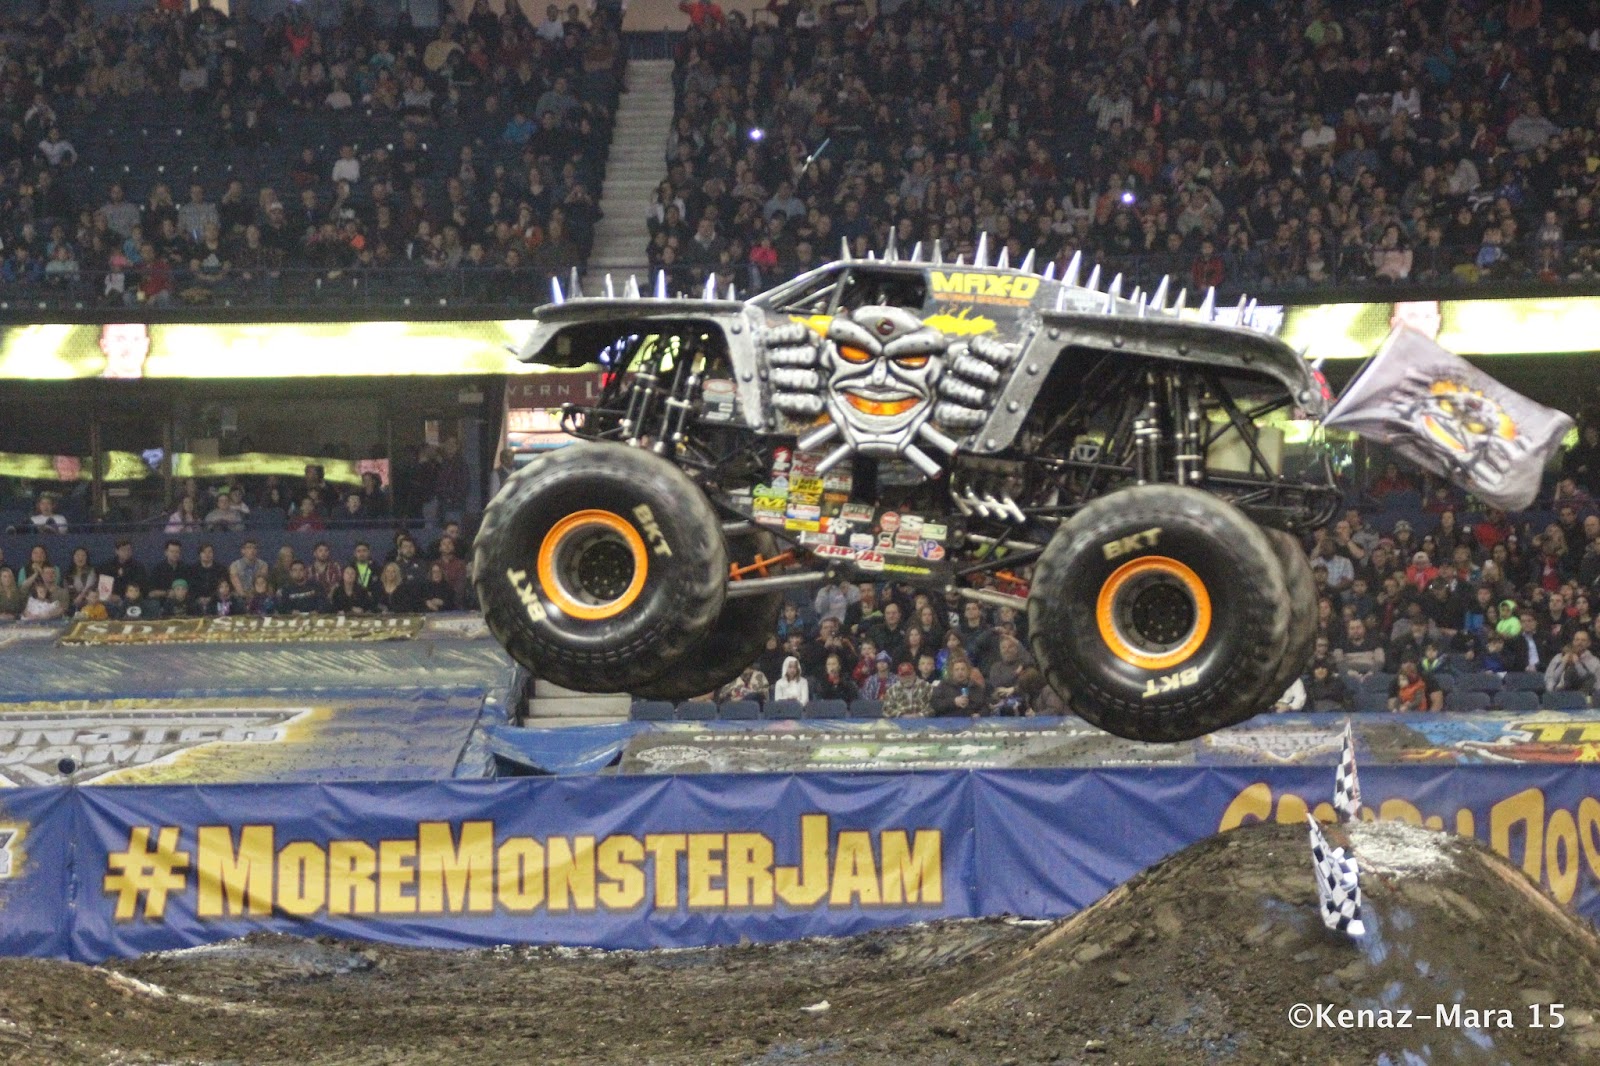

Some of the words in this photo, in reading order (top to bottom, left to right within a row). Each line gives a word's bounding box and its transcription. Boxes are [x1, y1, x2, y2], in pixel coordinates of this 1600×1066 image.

[930, 271, 1040, 299] MAX-D
[632, 504, 673, 557] BKT
[1102, 527, 1163, 560] BKT
[506, 567, 548, 622] BKT
[1141, 666, 1199, 698] BKT
[693, 734, 813, 742] OFFICIAL
[103, 814, 943, 922] #MOREMONSTERJAM
